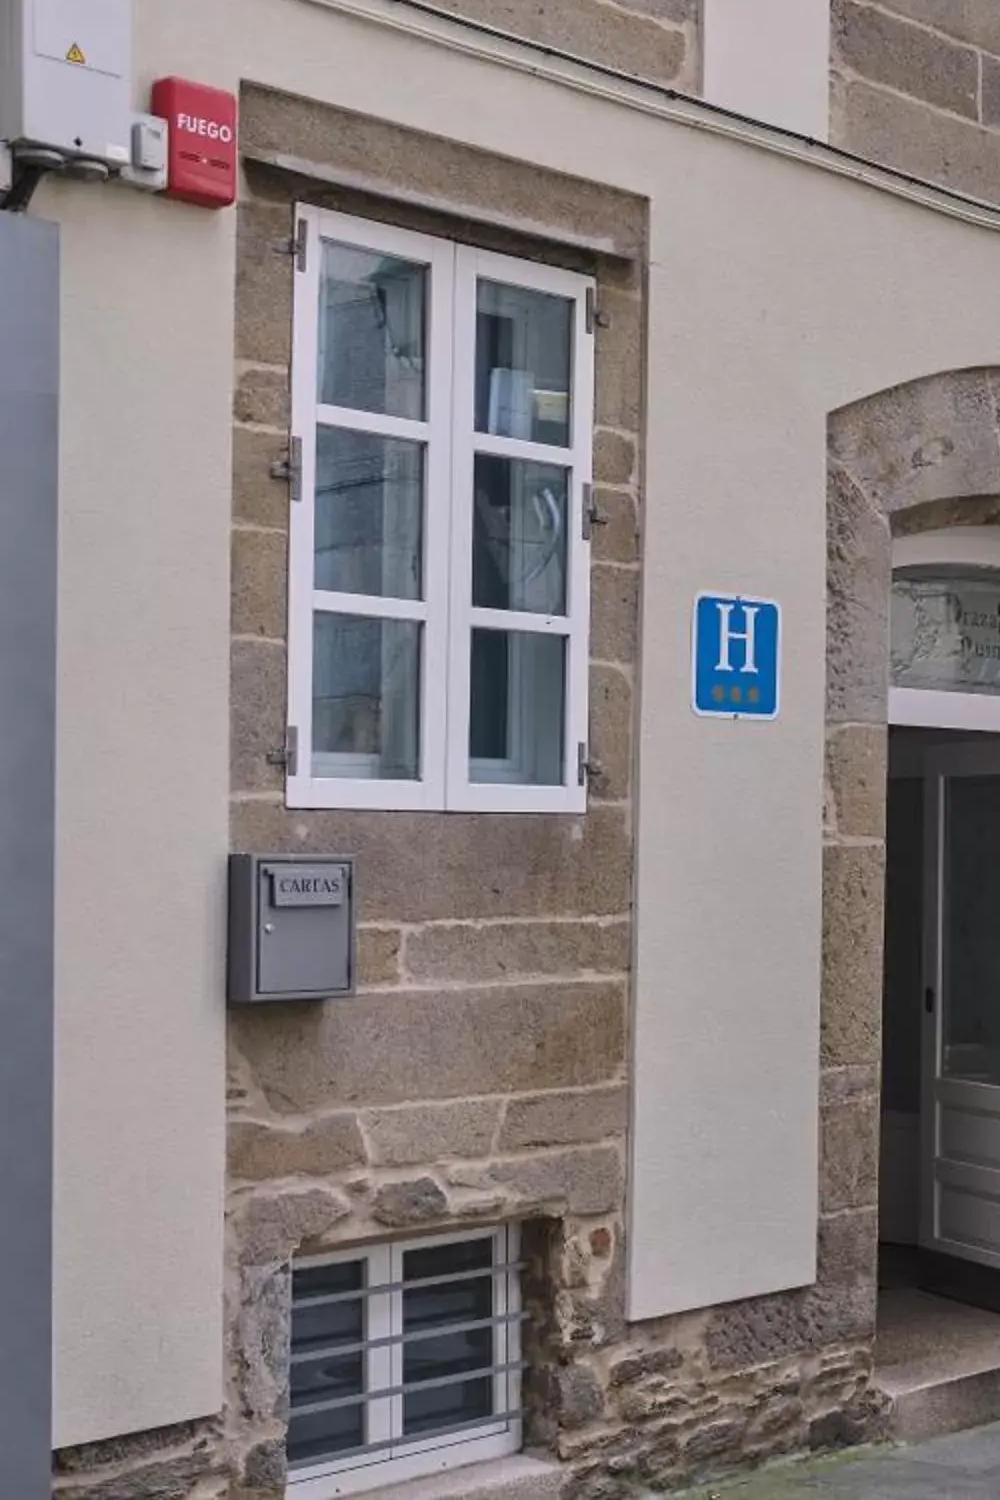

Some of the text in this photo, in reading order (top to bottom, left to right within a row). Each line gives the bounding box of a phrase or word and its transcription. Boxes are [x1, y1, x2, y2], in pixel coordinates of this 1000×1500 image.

[177, 113, 232, 143] FUEGO
[714, 603, 759, 674] H
[279, 877, 340, 894] CARTAS
